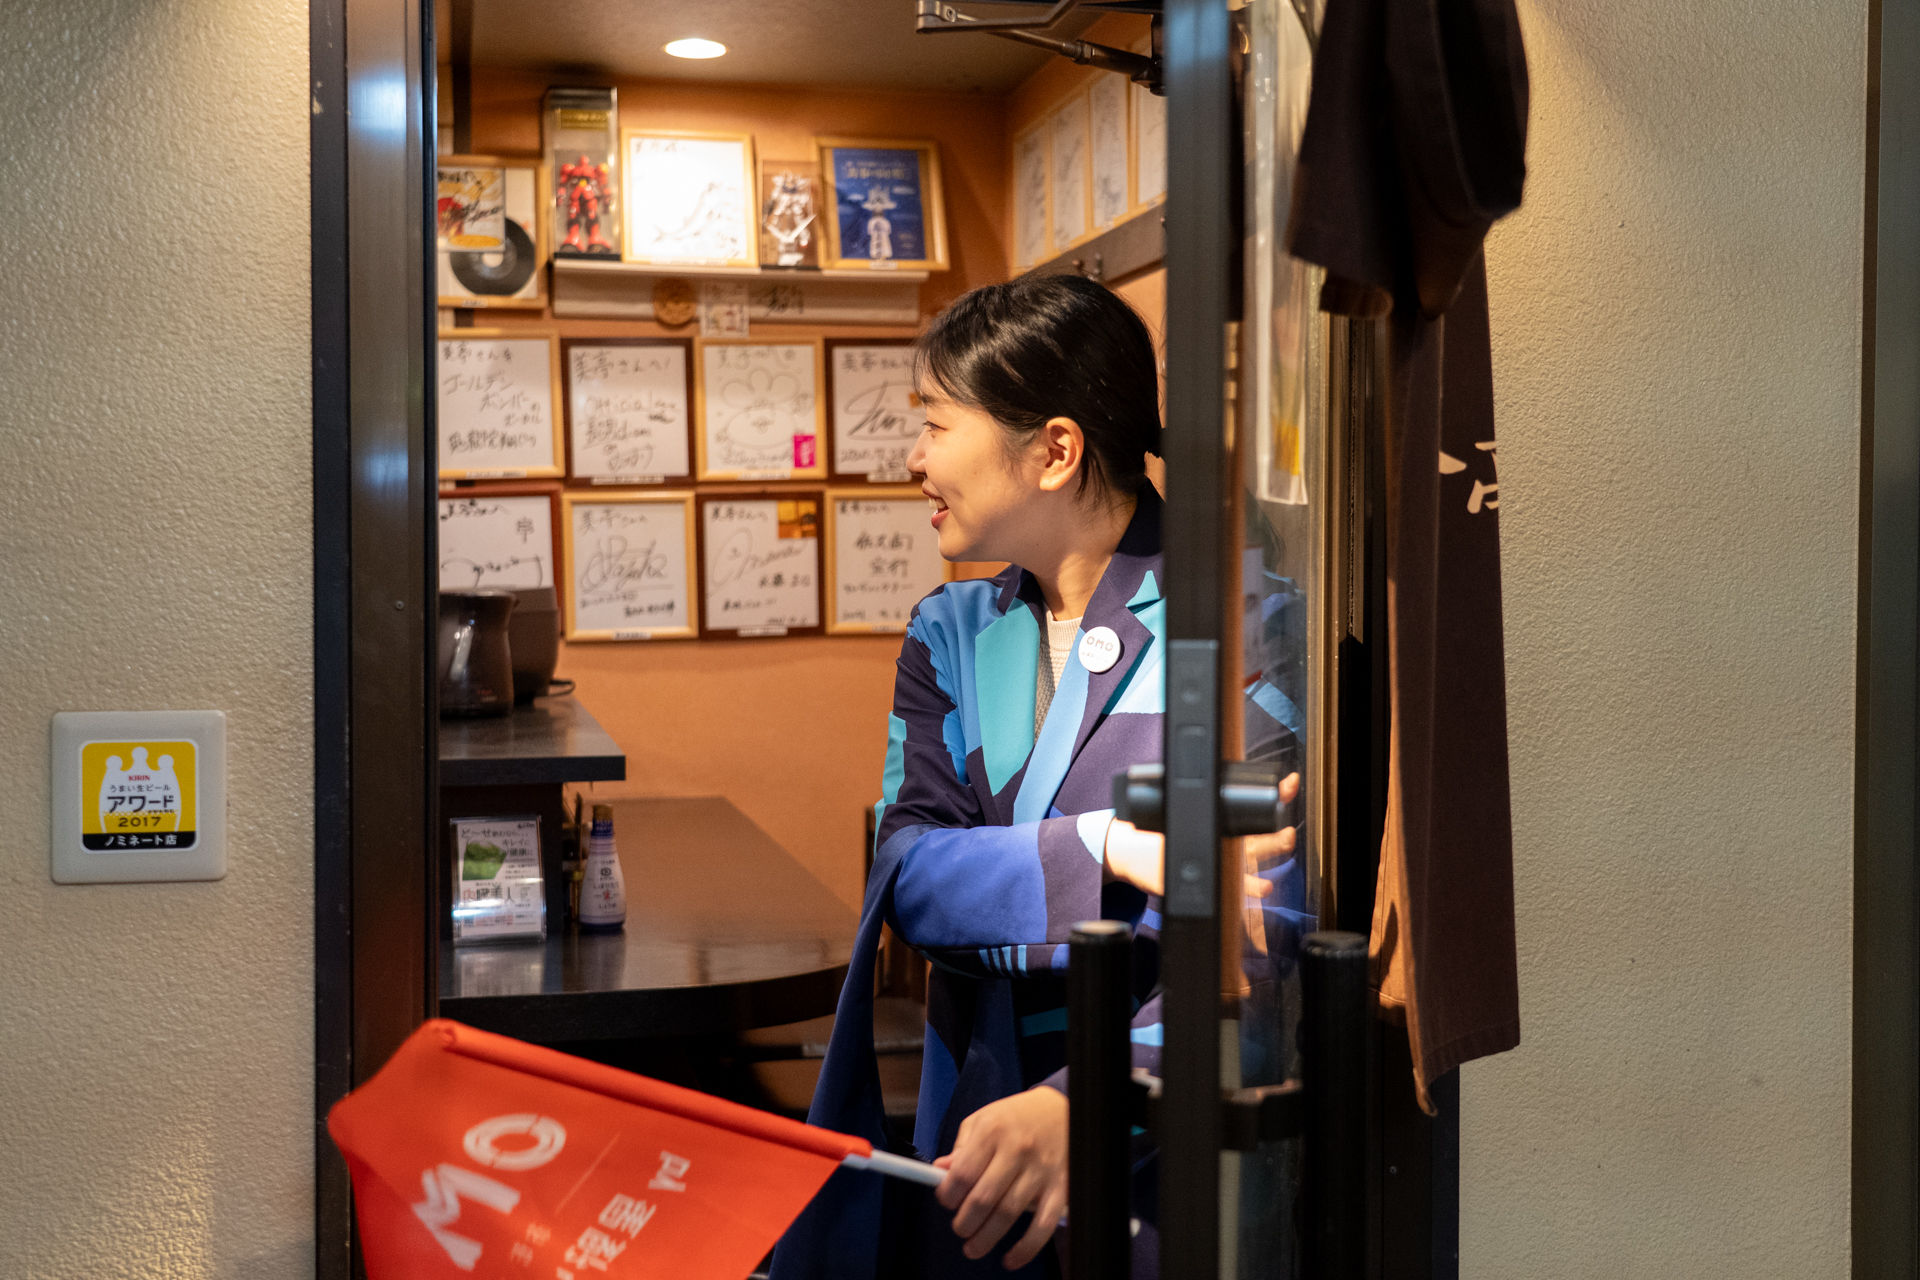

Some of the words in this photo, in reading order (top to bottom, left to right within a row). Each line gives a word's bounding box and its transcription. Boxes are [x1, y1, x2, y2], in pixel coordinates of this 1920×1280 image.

[443, 369, 514, 396] ゴールデン
[1086, 635, 1114, 652] OMO
[109, 784, 171, 792] うまい生ビール
[107, 795, 174, 813] アワード
[118, 816, 162, 827] 2017
[105, 835, 178, 847] ノミネート店
